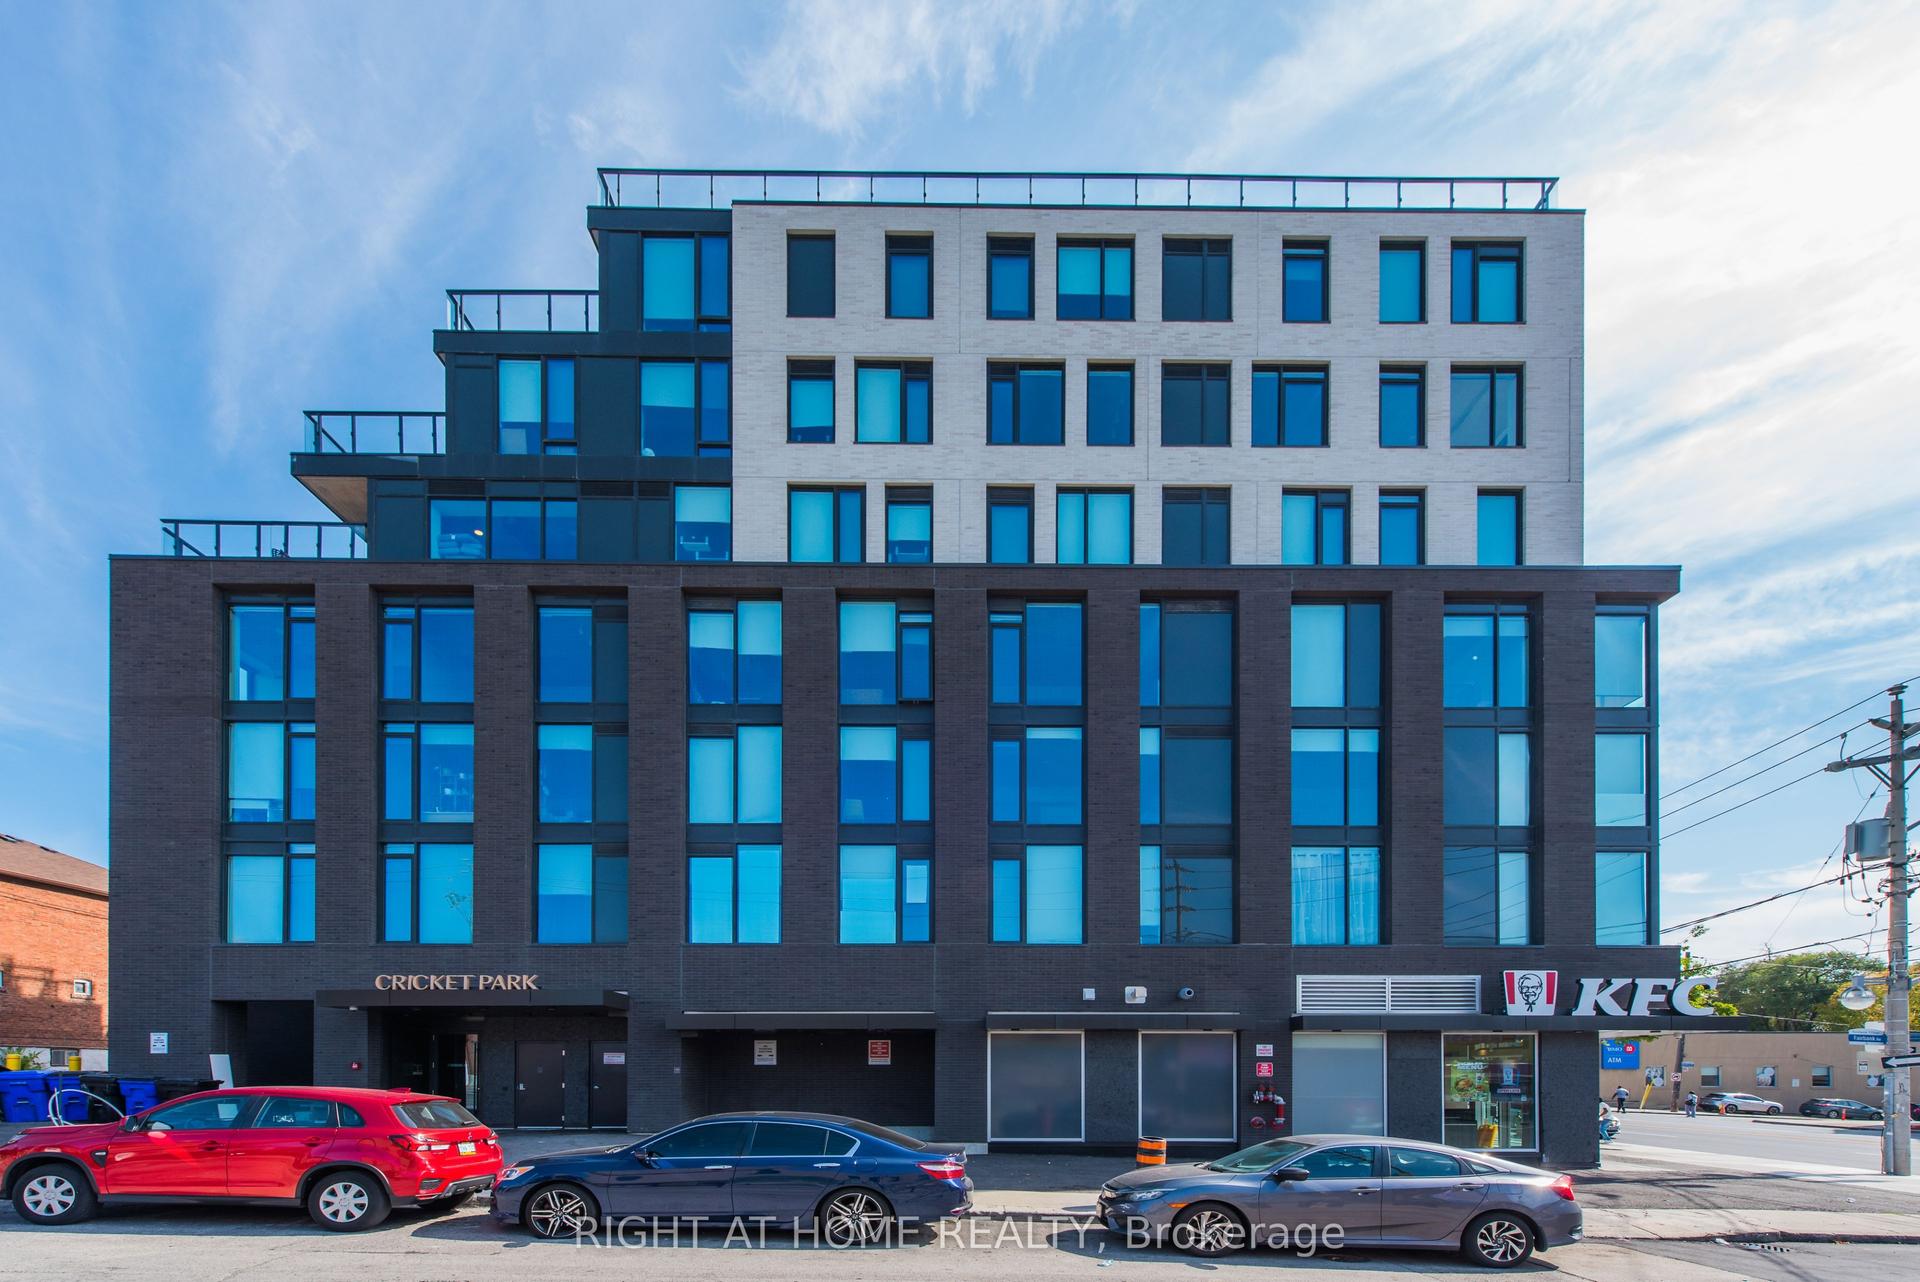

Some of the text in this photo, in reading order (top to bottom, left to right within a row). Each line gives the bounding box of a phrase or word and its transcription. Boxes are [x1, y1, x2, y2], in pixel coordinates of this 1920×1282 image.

[375, 974, 540, 991] CRICKET PARK
[1571, 977, 1719, 1017] KFC
